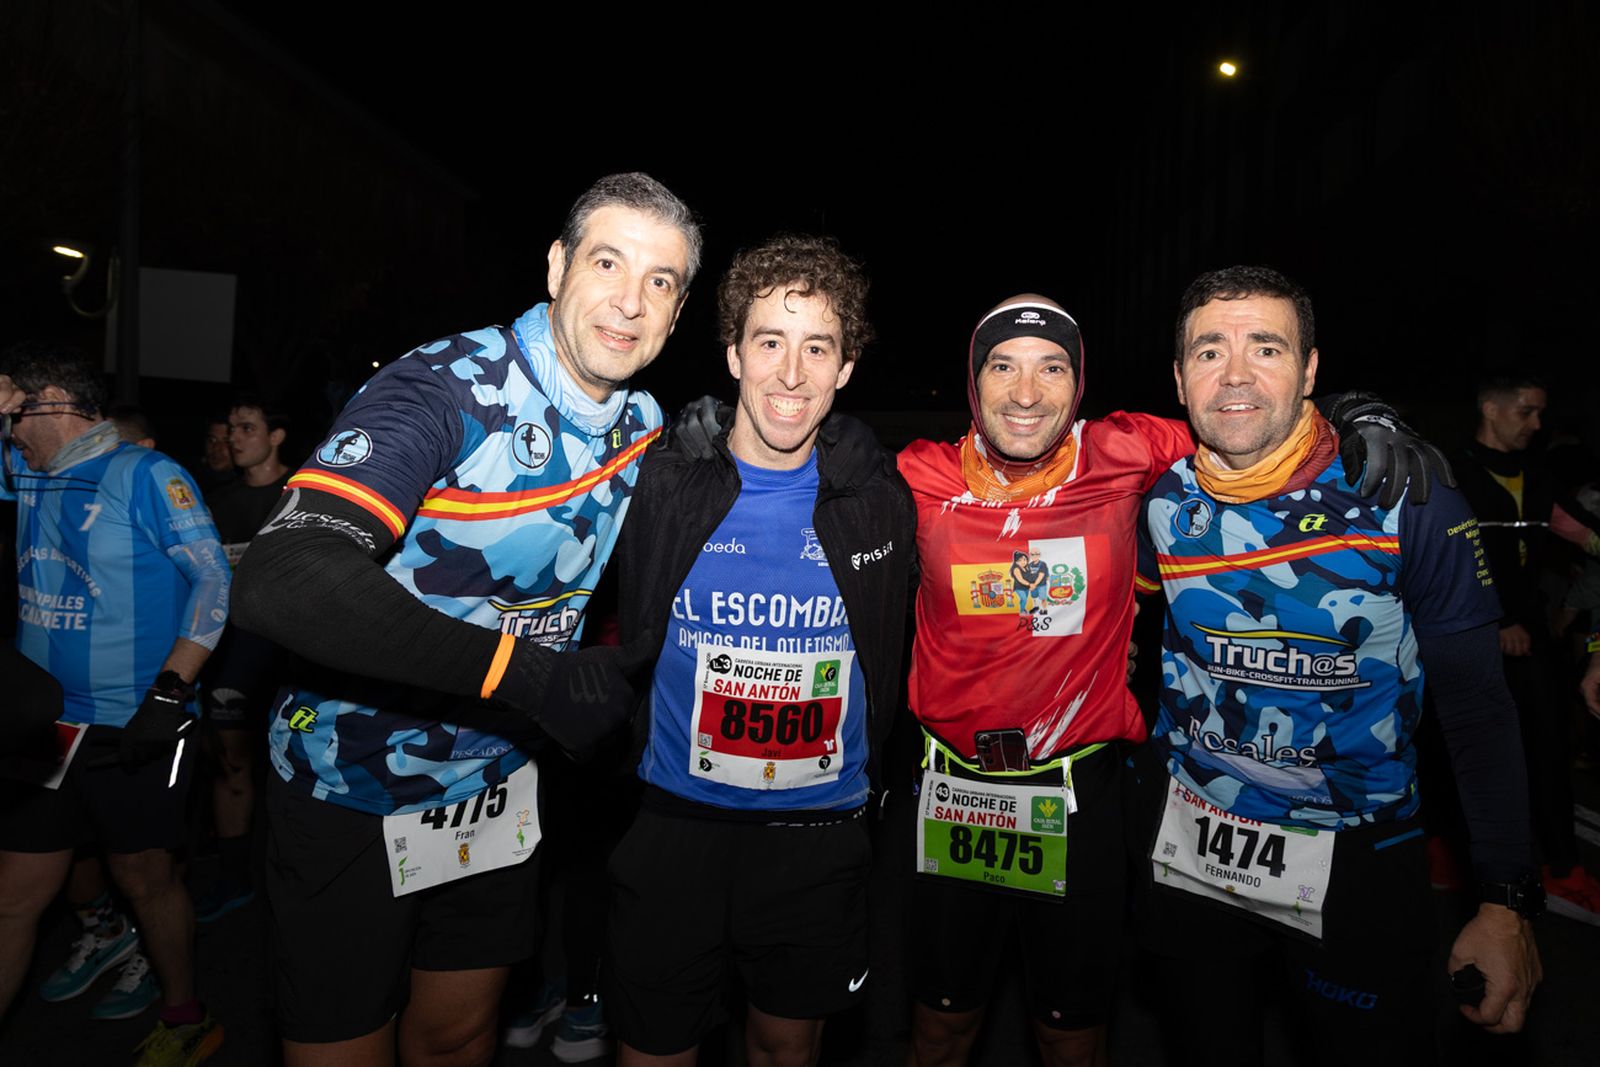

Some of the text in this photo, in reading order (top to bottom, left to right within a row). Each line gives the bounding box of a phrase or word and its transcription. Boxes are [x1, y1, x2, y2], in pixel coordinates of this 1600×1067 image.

[78, 503, 102, 531] 7
[672, 588, 700, 621] EL
[1017, 616, 1053, 632] P&S
[740, 635, 767, 653] DEL
[1205, 635, 1357, 677] Truch@s
[733, 663, 803, 682] NOCHE DE
[713, 678, 802, 701] SAN ANTÓN
[720, 699, 824, 745] 8560
[761, 748, 782, 758] Javi
[1189, 715, 1318, 769] Rosales
[936, 785, 949, 798] 43
[951, 792, 1017, 814] NOCHE DE
[1184, 788, 1208, 811] SAN
[934, 806, 1018, 830] SAN ANTÓN
[455, 829, 476, 841] Fran
[949, 825, 1044, 875] 8475
[1195, 815, 1287, 879] 1474
[983, 871, 1006, 884] Paco
[1204, 863, 1263, 889] FERNANDO
